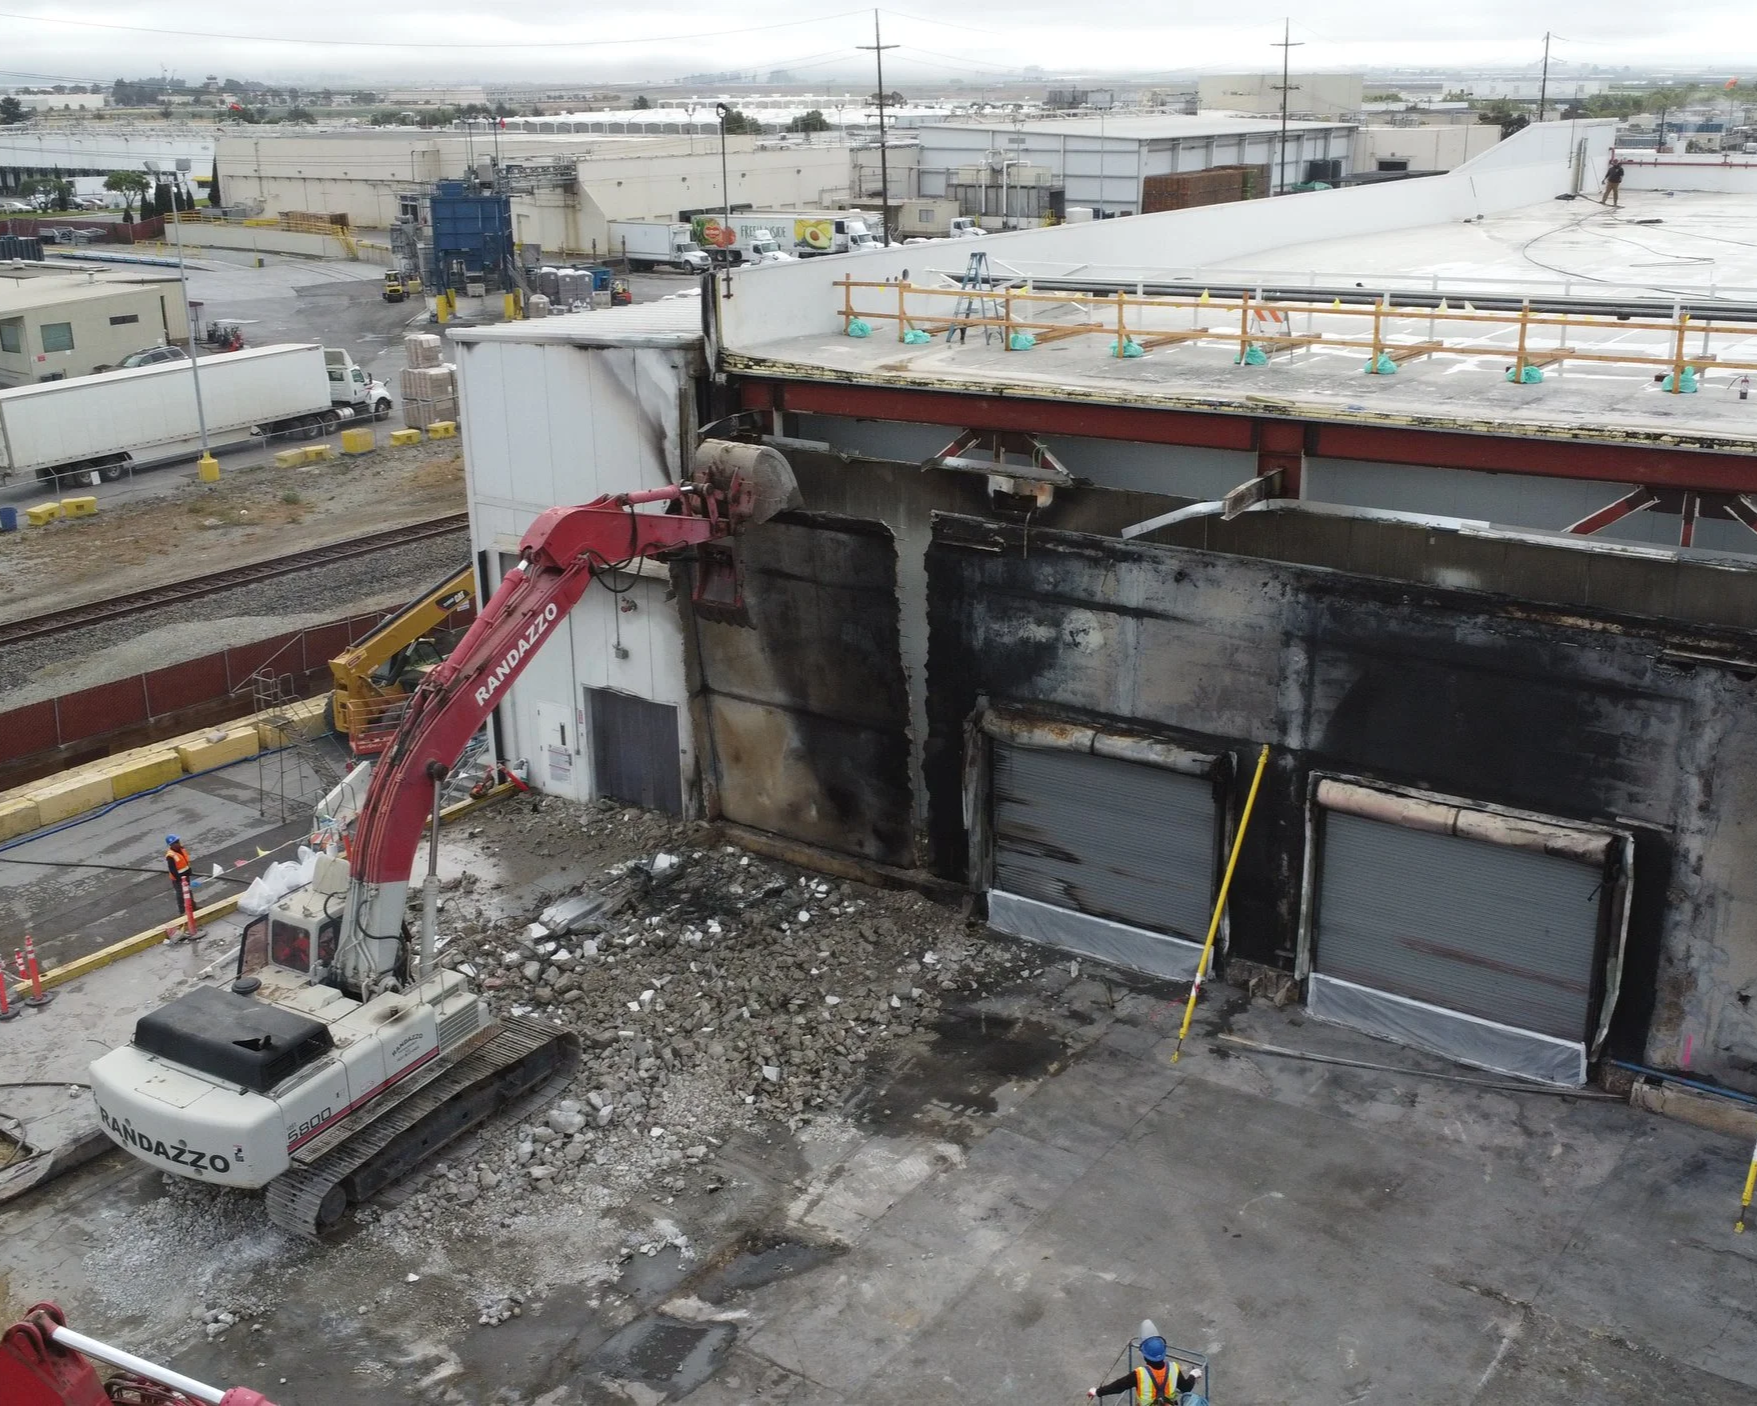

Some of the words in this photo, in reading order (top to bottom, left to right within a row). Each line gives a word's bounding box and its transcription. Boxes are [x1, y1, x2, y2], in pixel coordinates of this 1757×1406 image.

[475, 603, 558, 706] RANDAZZO
[100, 1107, 230, 1173] RANDAZZO
[288, 1107, 332, 1144] 5800
